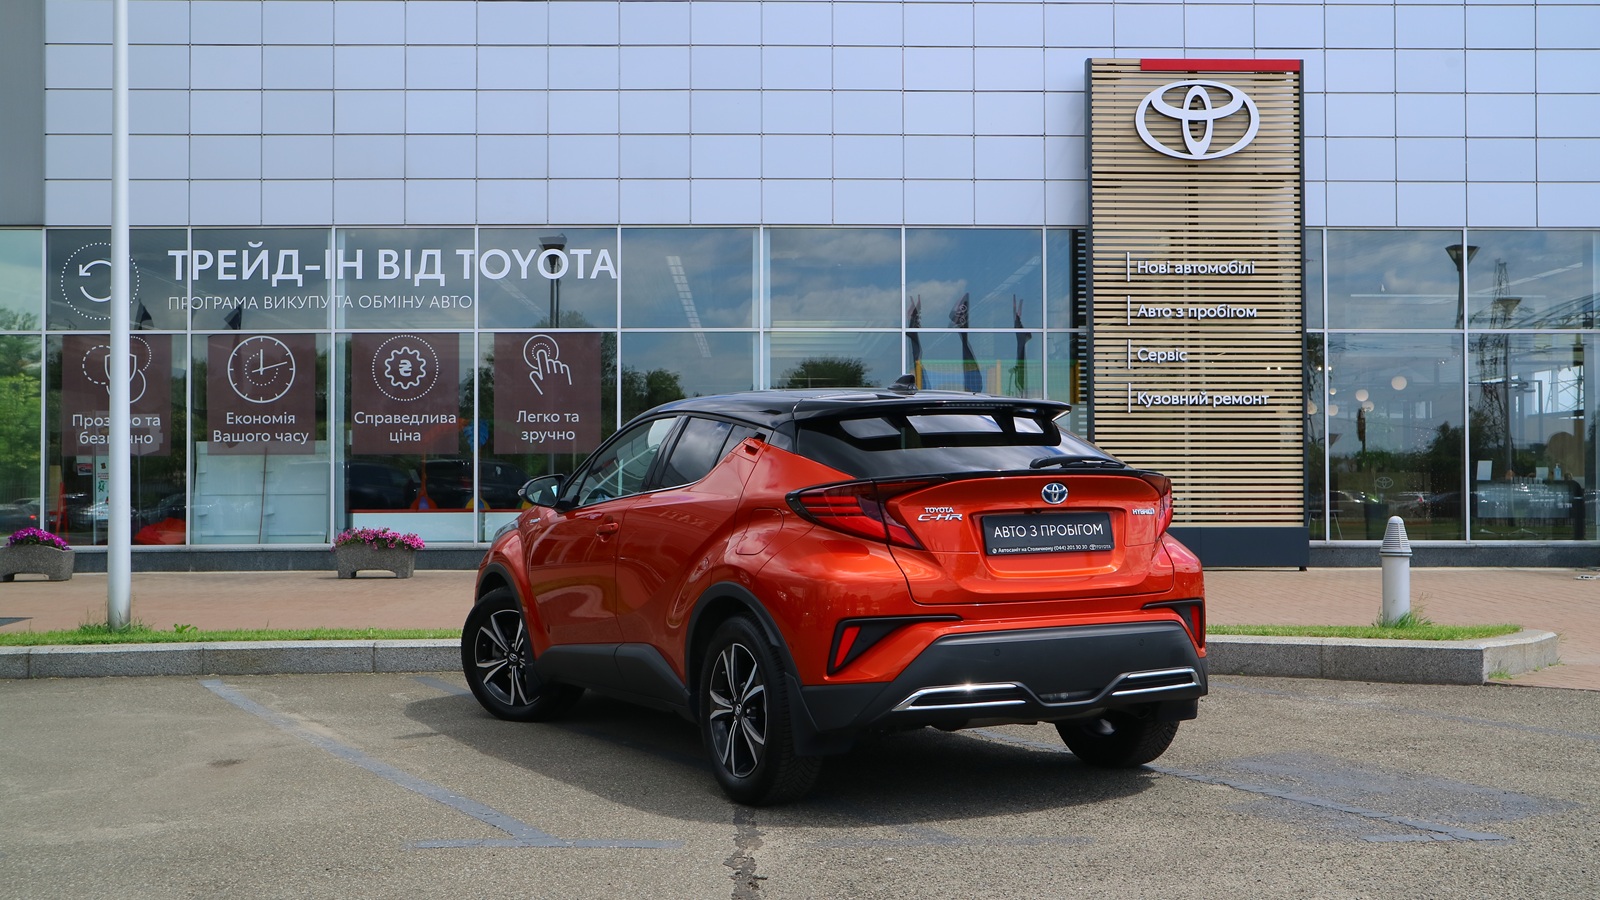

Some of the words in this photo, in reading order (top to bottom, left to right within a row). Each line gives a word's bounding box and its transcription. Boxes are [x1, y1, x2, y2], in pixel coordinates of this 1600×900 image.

[167, 242, 363, 287] ТРЕЙД-ІН
[378, 249, 446, 287] ВІД
[456, 248, 618, 280] TOYOTA
[1137, 261, 1171, 274] Нові
[1174, 260, 1256, 274] автомобілі
[168, 296, 259, 310] ПРОГРАМА
[264, 295, 331, 309] ВИКУПУ
[334, 295, 354, 309] ТА
[358, 295, 425, 309] ОБМІНУ
[430, 295, 473, 309] АВТО
[1137, 305, 1172, 318] Авто
[1175, 308, 1184, 318] з
[1187, 304, 1257, 320] пробігом
[1137, 348, 1188, 364] Сервіс
[1137, 391, 1209, 408] Кузовний
[1213, 394, 1269, 408] ремонт
[72, 414, 142, 430] Прозо
[145, 416, 161, 426] та
[225, 412, 296, 425] Економія
[353, 411, 457, 426] Справедлива
[516, 411, 560, 423] Легко
[564, 413, 580, 423] та
[213, 430, 271, 443] Вашого
[274, 432, 309, 445] часу
[389, 428, 421, 443] ціна
[520, 430, 576, 445] зручно
[917, 513, 963, 521] C-HR
[924, 506, 954, 514] TOYOTA
[994, 525, 1027, 538] АВТО
[1040, 523, 1104, 537] ПРОБІГОМ
